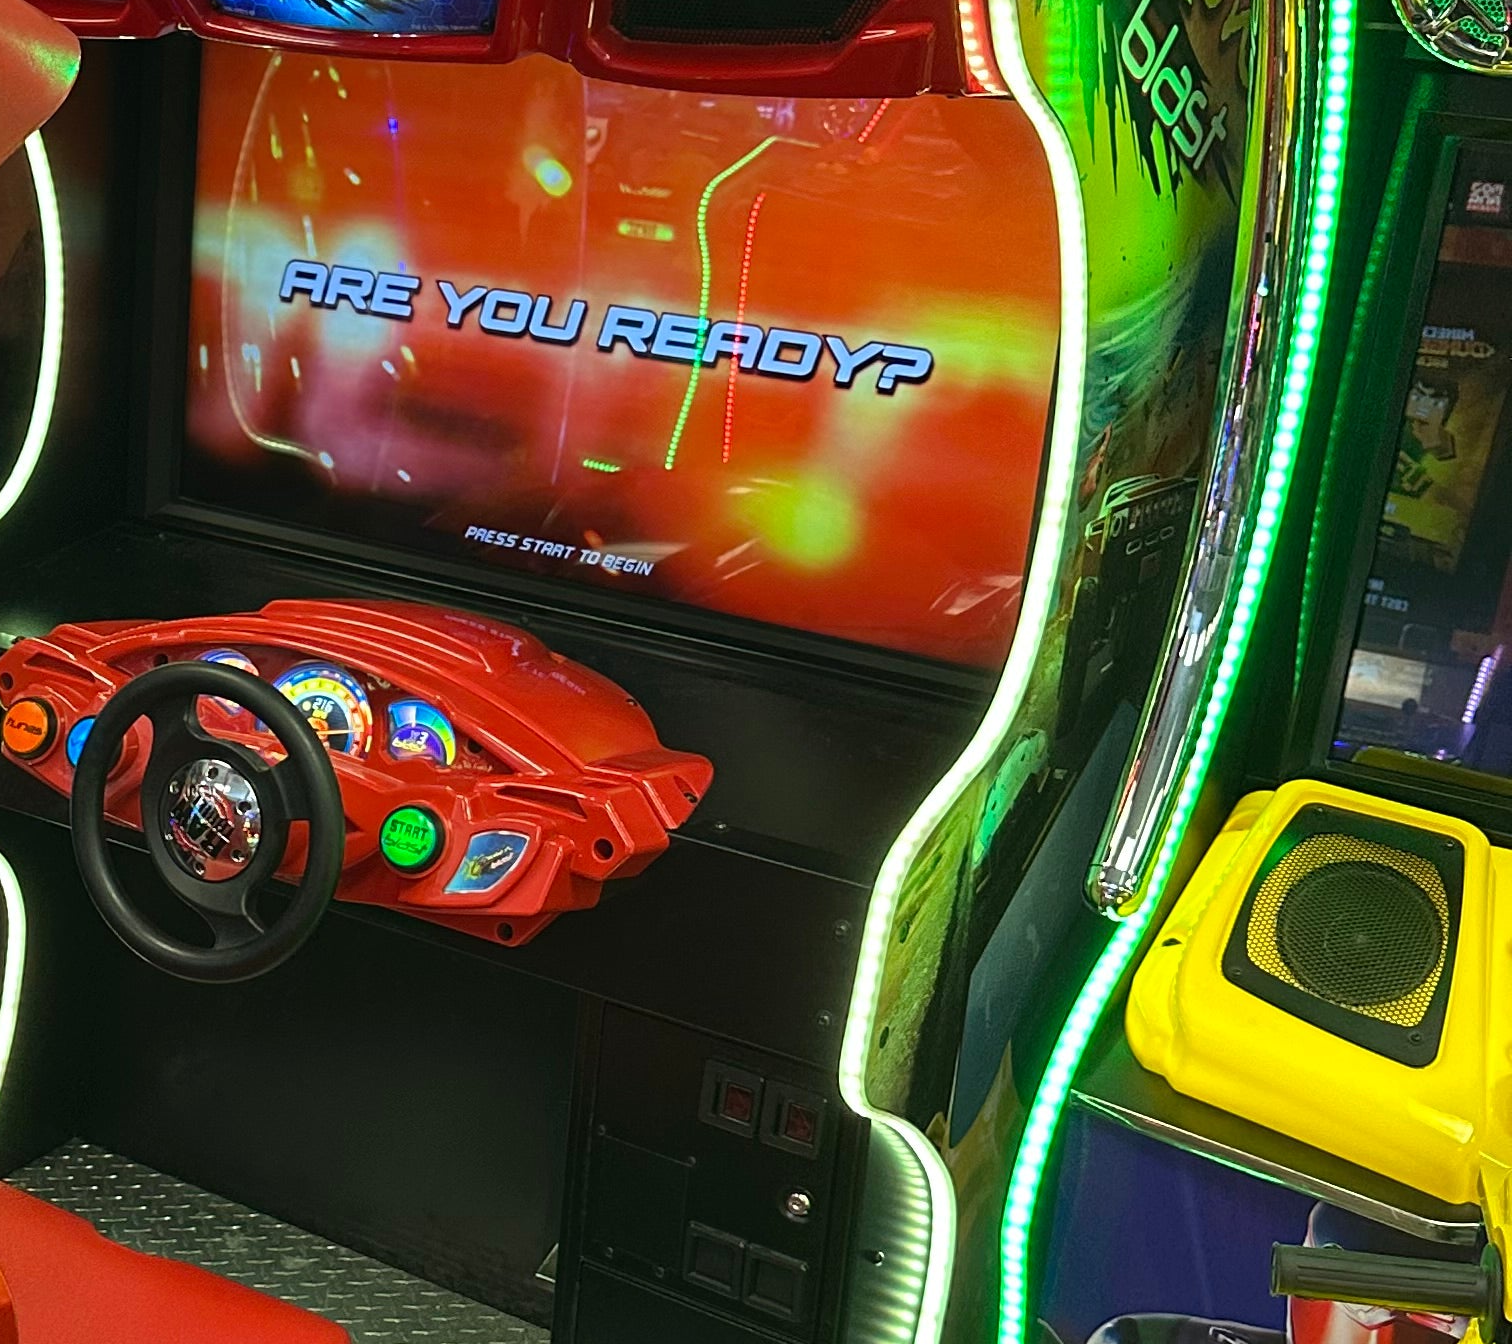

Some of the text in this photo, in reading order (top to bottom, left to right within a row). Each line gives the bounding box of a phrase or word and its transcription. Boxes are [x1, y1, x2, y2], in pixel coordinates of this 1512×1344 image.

[279, 259, 934, 393] ARE YOU READY?
[465, 525, 655, 577] PRESS START TO BEGIN
[384, 833, 428, 855] blast
[390, 819, 429, 841] START
